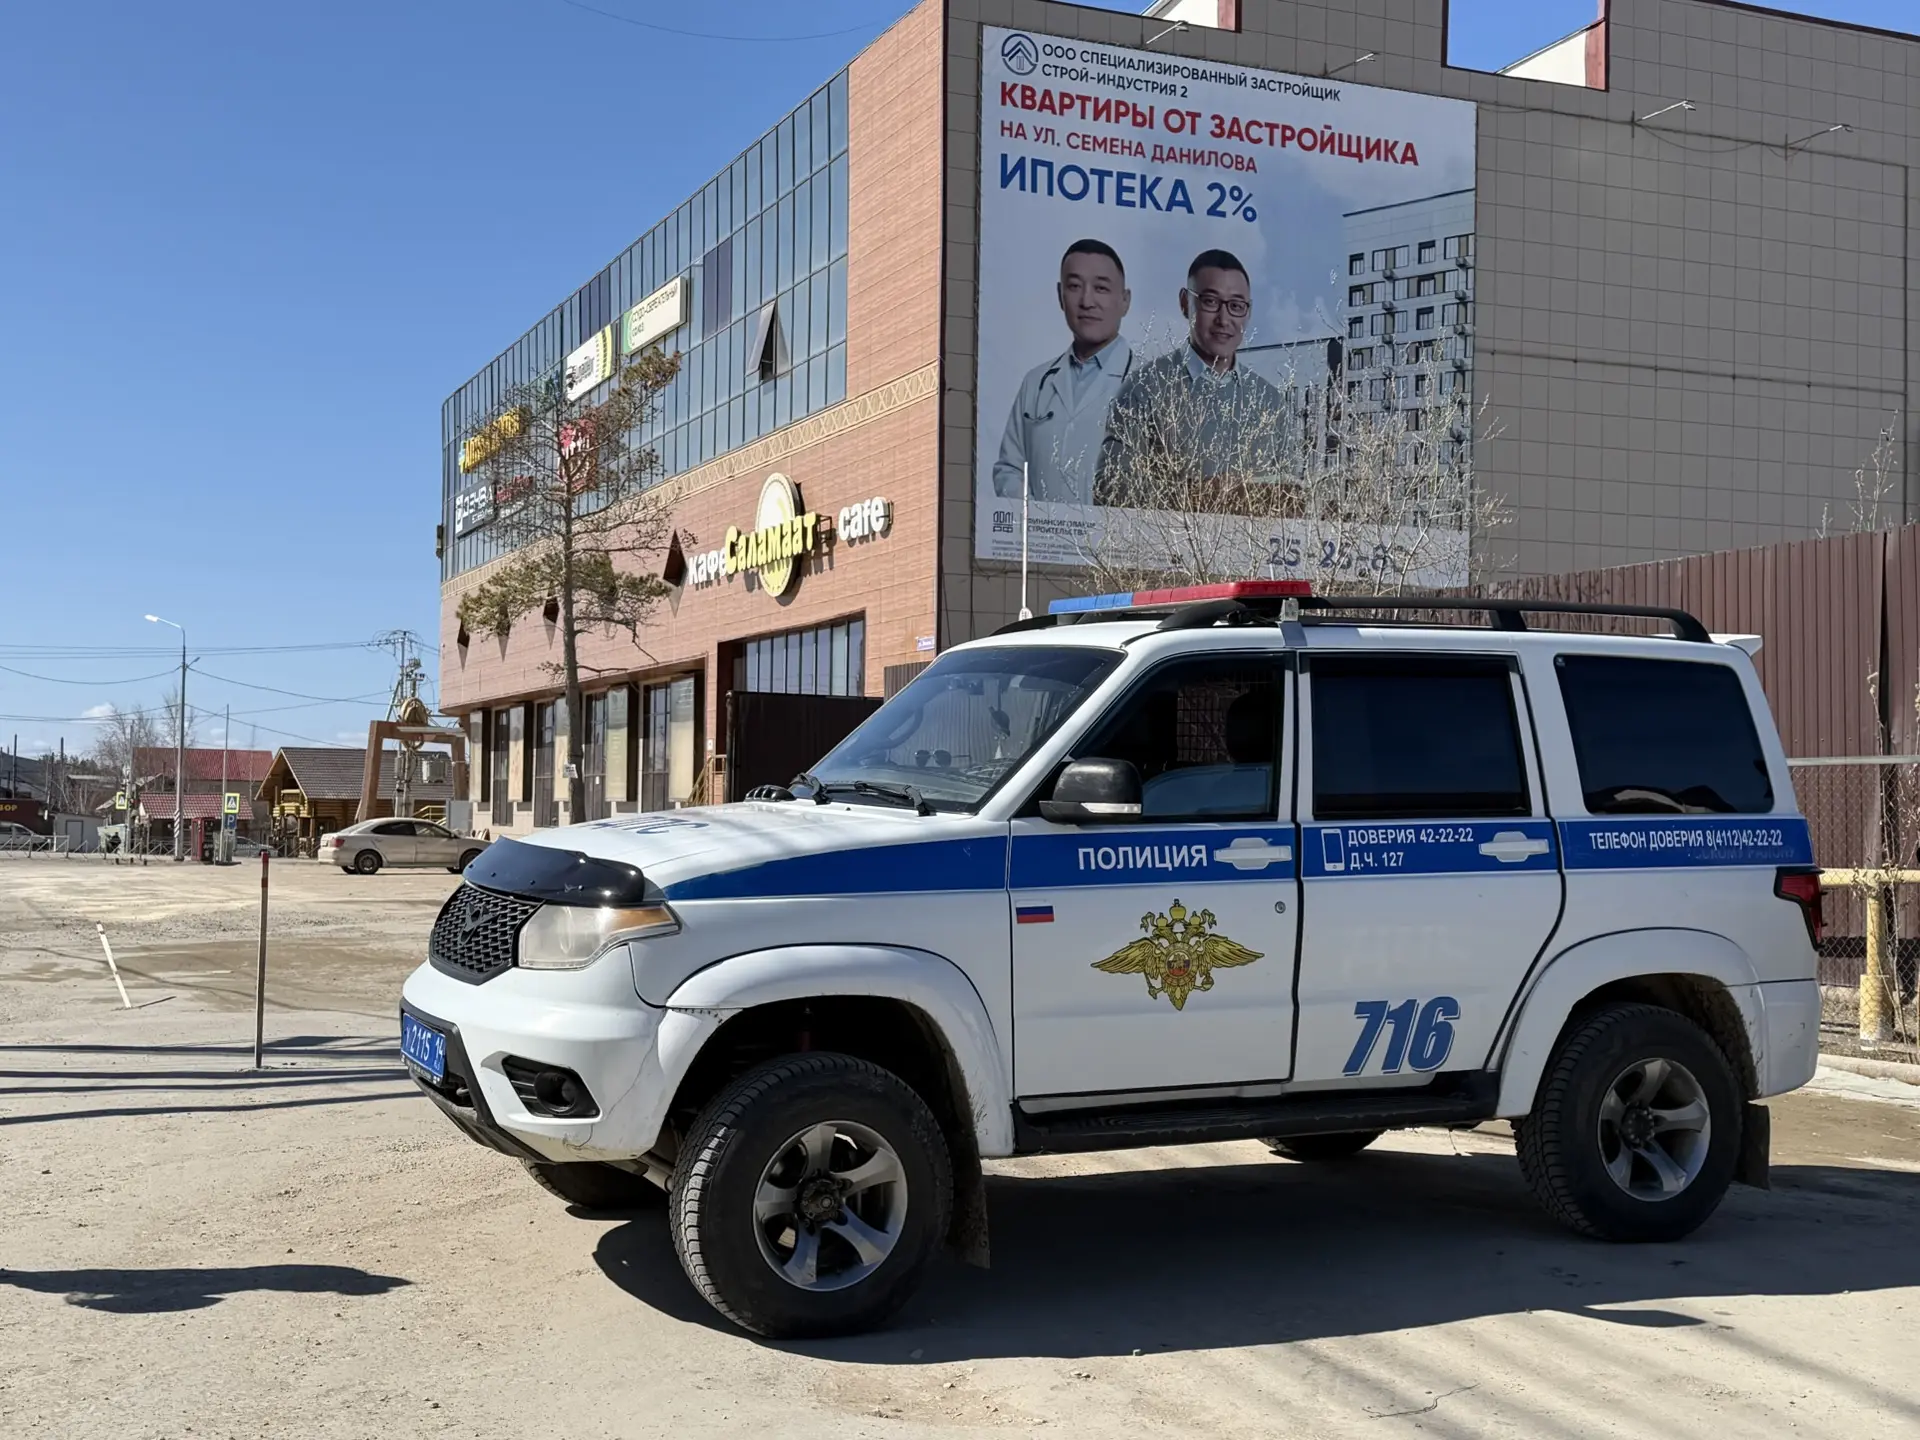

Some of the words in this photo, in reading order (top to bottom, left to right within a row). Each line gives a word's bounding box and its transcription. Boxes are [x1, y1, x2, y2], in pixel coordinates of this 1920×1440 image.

[1042, 44, 1076, 61] ООО
[1080, 50, 1247, 88] СПЕЦИАЛИЗИРОВАННЫЙ
[1250, 76, 1341, 102] ЗАСТРОЙЩИК
[1042, 64, 1177, 98] СТРОЙ-ИНДУСТРИЯ
[1180, 85, 1188, 98] 2
[1000, 82, 1154, 130] КВАРТИРЫ
[1163, 107, 1202, 137] ОТ
[1210, 113, 1419, 166] ЗАСТРОЙЩИКА
[1001, 120, 1028, 142] НА
[1033, 125, 1061, 148] УЛ.
[1066, 132, 1146, 160] СЕМЕНА
[1151, 144, 1258, 174] ДАНИЛОВА
[1000, 153, 1195, 215] ИПОТЕКА
[1206, 182, 1257, 223] 2%
[838, 496, 889, 541] cafe
[1078, 845, 1207, 871] ПОЛИЦИЯ
[1348, 829, 1416, 847] ДОВЕРИЯ
[1420, 828, 1474, 843] 42-22-22
[1589, 832, 1647, 849] ТЕЛЕФОН
[1649, 830, 1704, 851] ДОВЕРИЯ
[1706, 829, 1783, 850] 8(4112)42-22-22
[1350, 852, 1378, 870] Д.Ч.
[1382, 852, 1404, 867] 127
[1342, 996, 1461, 1077] 716
